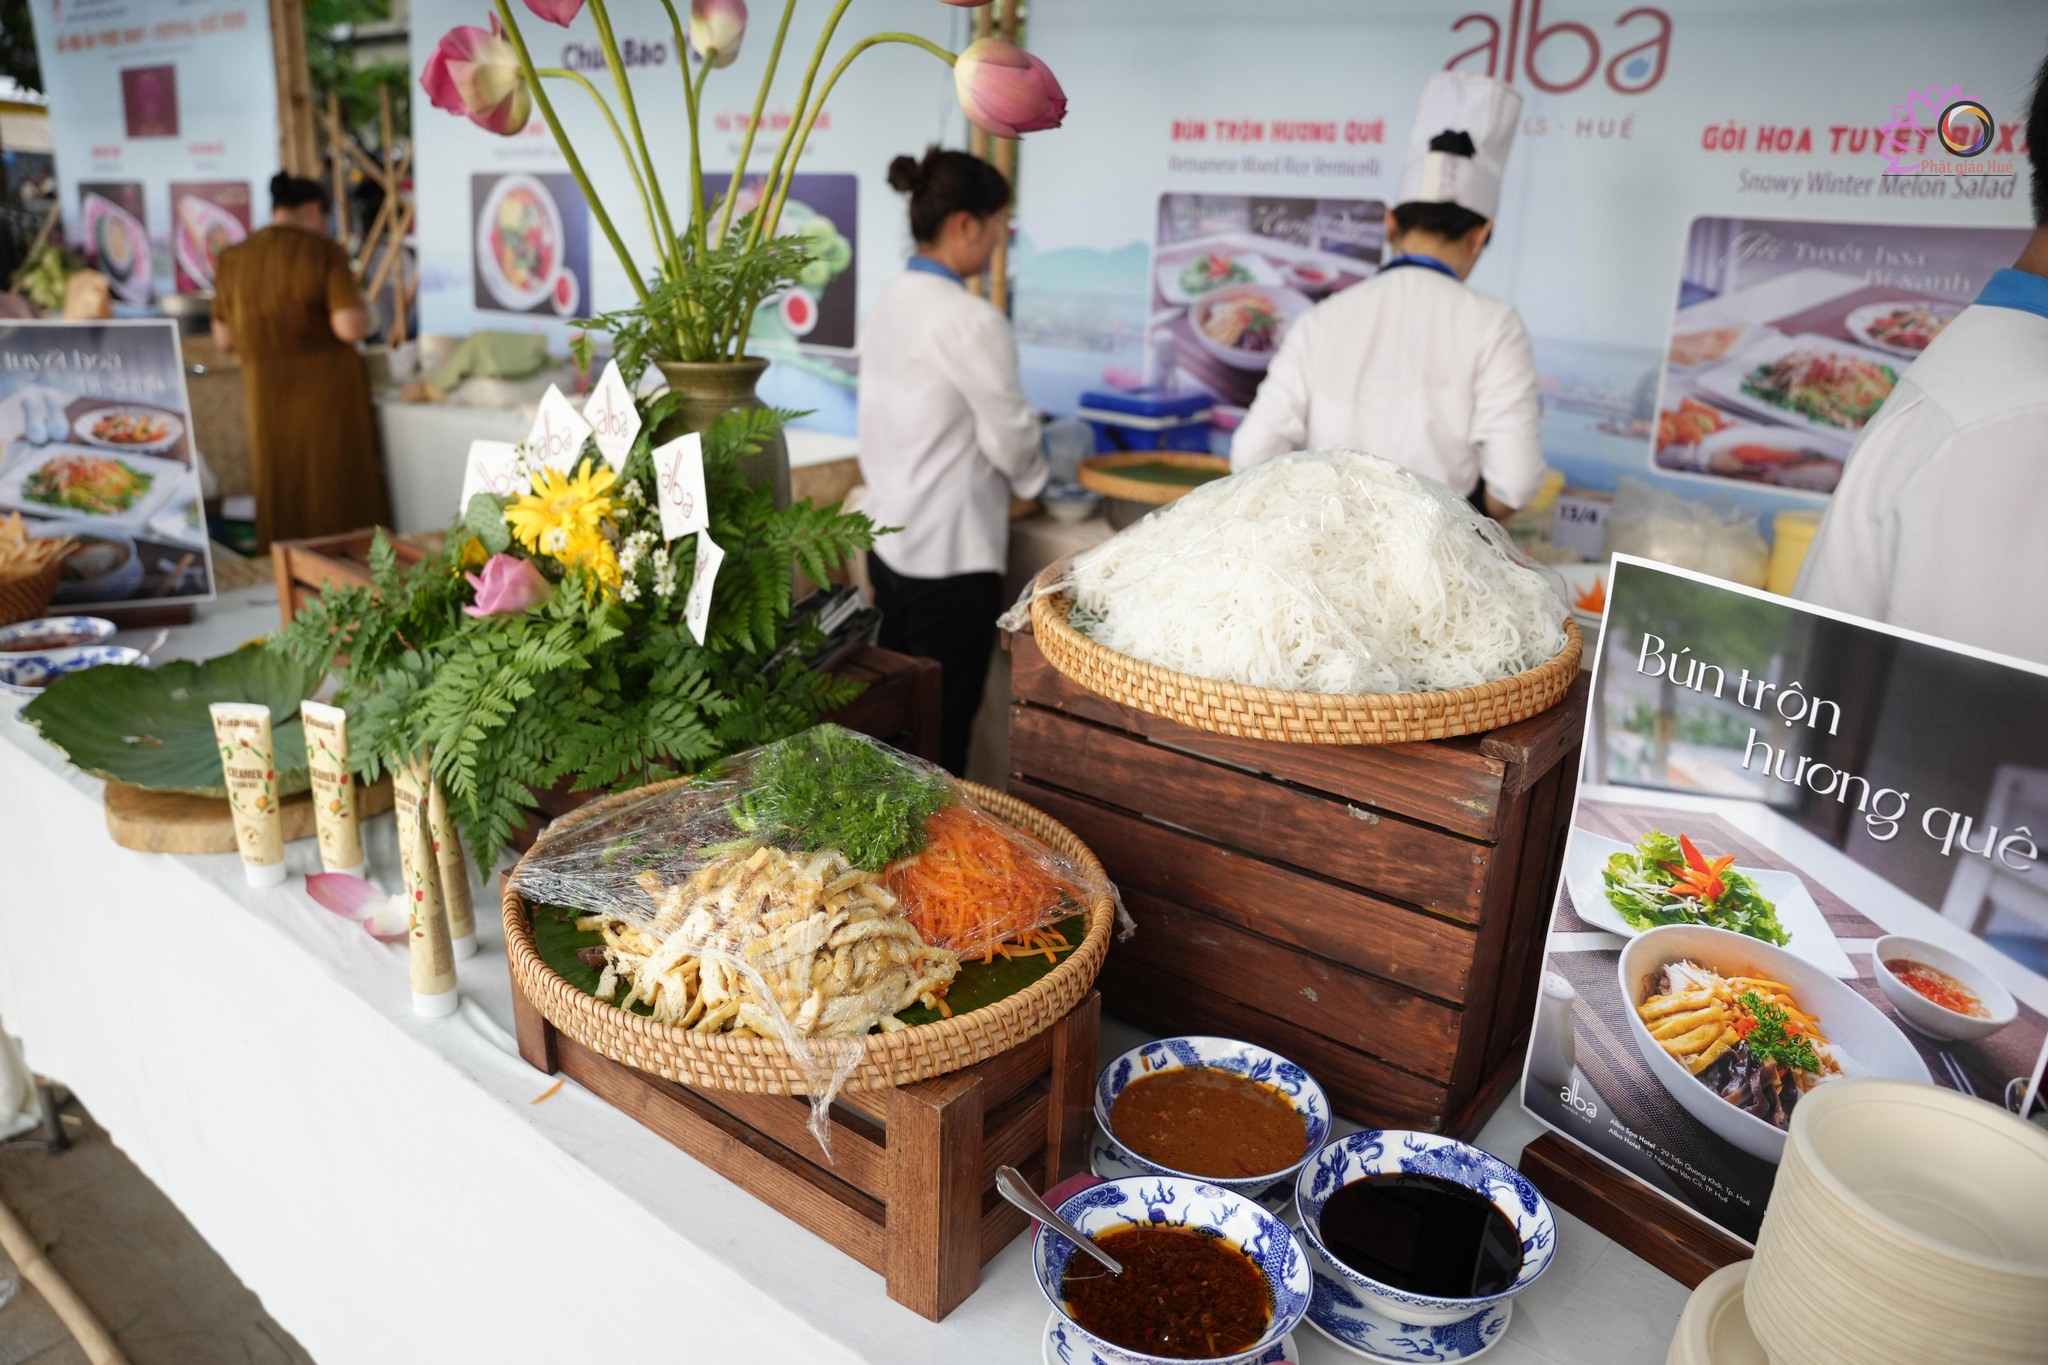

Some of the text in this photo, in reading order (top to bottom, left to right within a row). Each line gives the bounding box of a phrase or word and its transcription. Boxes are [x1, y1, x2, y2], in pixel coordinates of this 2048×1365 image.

[1444, 0, 1673, 95] alba
[1756, 124, 1812, 153] HOA
[1738, 168, 2018, 200] Snowy Winter Melon Salad
[1637, 632, 1841, 736] Bún trộn
[1742, 728, 2039, 871] hương quê
[1560, 1078, 1597, 1118] alba
[1608, 1128, 1623, 1140] Alba
[1624, 1137, 1641, 1150] Hotel
[1610, 1118, 1625, 1131] Alba
[1625, 1127, 1638, 1139] Spa
[1639, 1135, 1656, 1150] Hotel
[1660, 1148, 1670, 1157] 29
[1684, 1163, 1707, 1181] Quang
